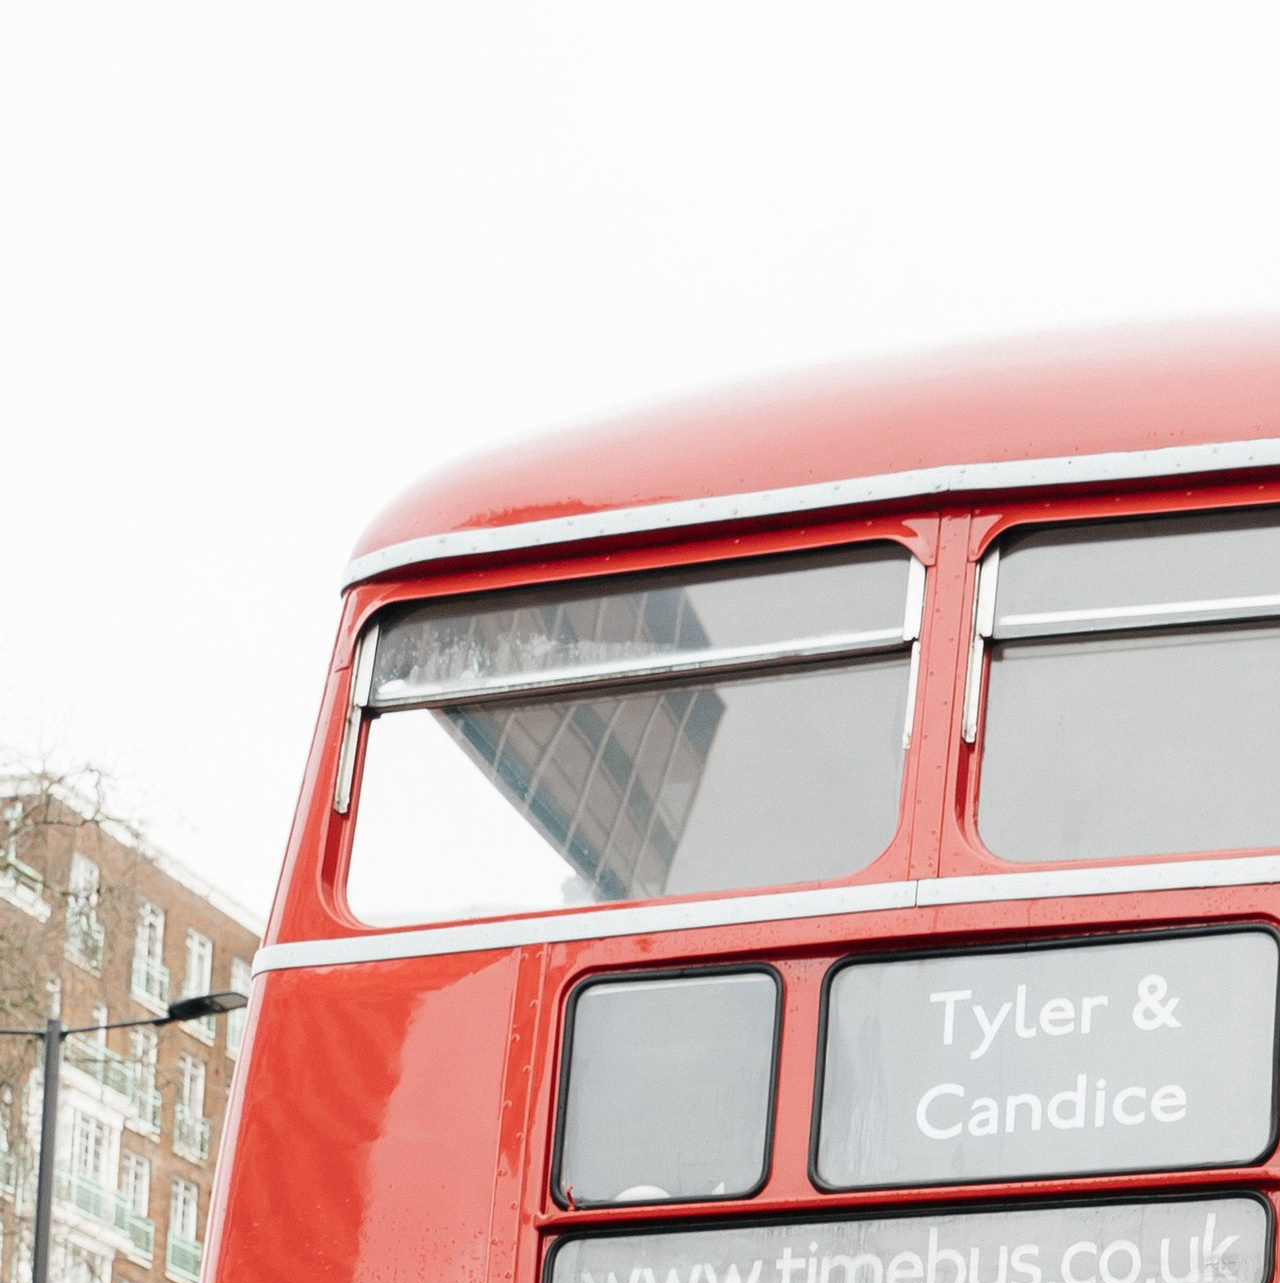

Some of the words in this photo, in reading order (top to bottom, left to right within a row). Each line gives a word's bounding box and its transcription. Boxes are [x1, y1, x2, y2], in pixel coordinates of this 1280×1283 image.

[930, 984, 1108, 1060] Tyler
[1132, 974, 1182, 1031] &
[916, 1073, 1187, 1140] Candice
